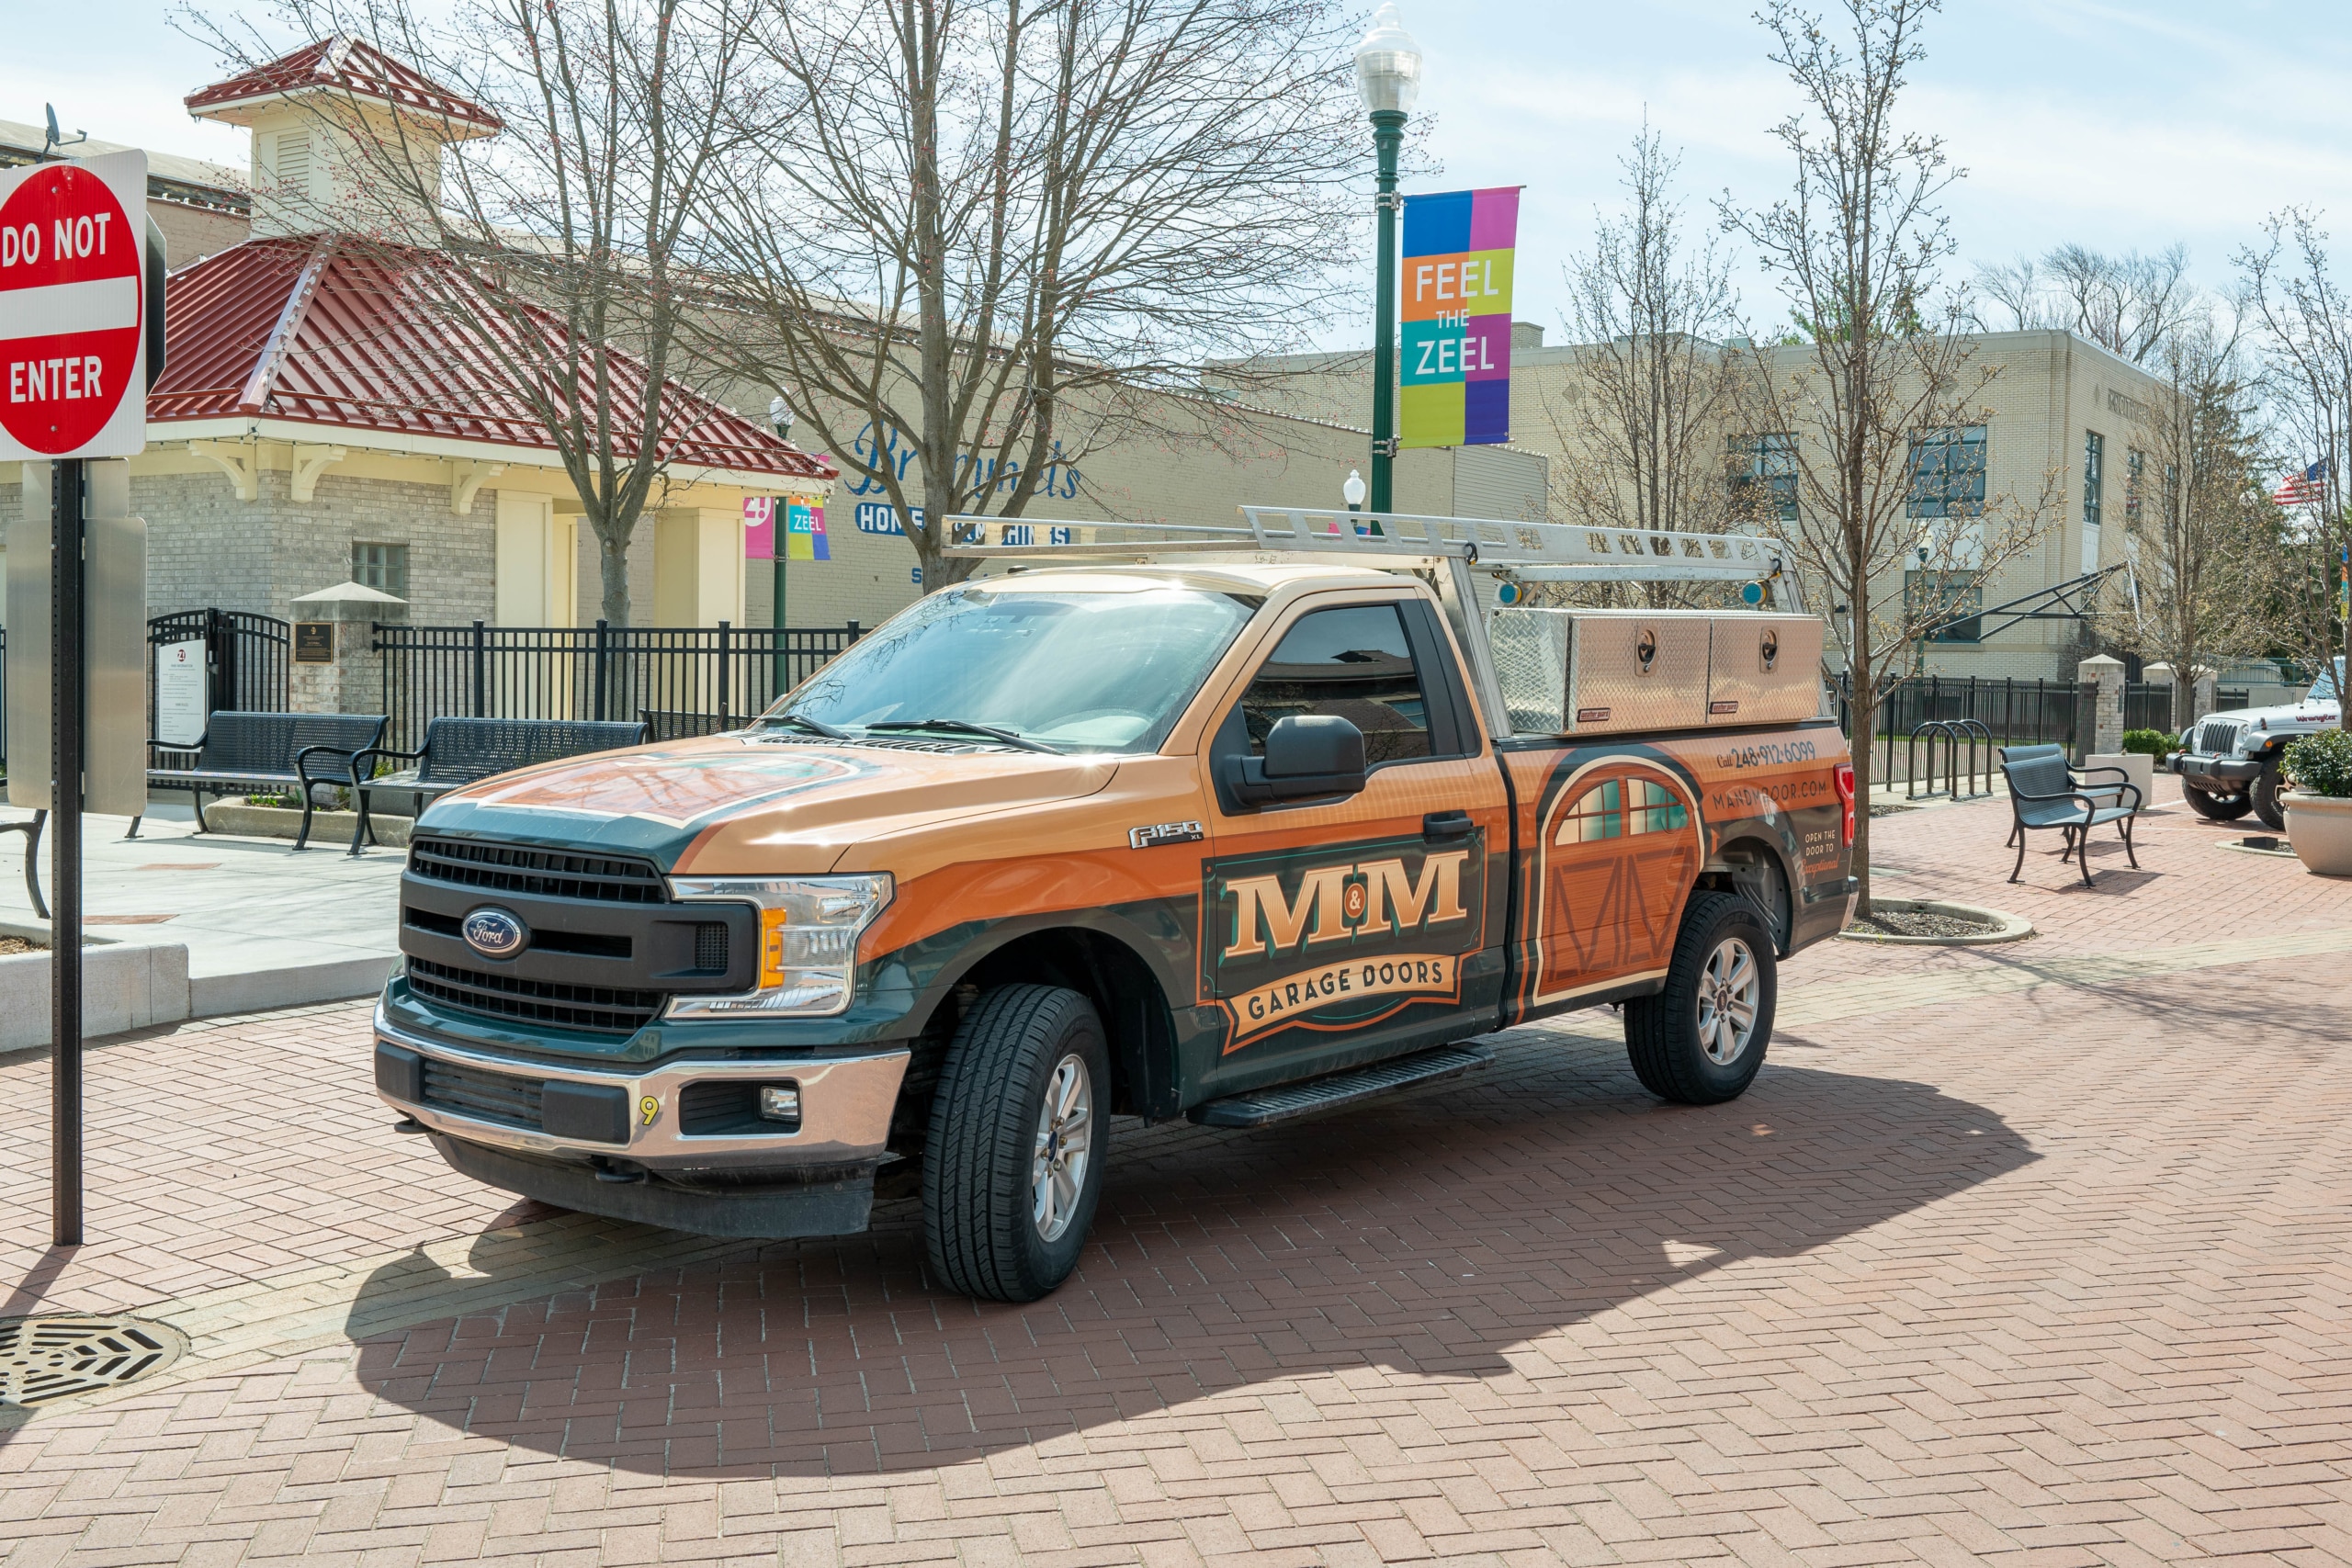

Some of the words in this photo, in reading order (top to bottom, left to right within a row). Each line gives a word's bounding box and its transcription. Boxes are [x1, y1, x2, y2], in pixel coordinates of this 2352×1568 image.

[2, 222, 40, 267] DO
[54, 211, 111, 261] NOT
[1416, 259, 1499, 302] FEEL
[1435, 308, 1471, 329] THE
[1415, 336, 1495, 375] ZEEL
[10, 355, 103, 403] ENTER
[794, 514, 821, 531] ZEEL
[2295, 713, 2337, 723] Wrangler
[1716, 753, 1733, 769] Call
[1804, 831, 1822, 843] OPEN
[1824, 829, 1836, 840] THE
[1805, 844, 1824, 857] DOOR
[1826, 842, 1834, 853] TO
[473, 919, 505, 944] Ford
[1248, 968, 1351, 1021] GARAGE
[1363, 961, 1443, 987] DOORS
[639, 1095, 660, 1126] 9
